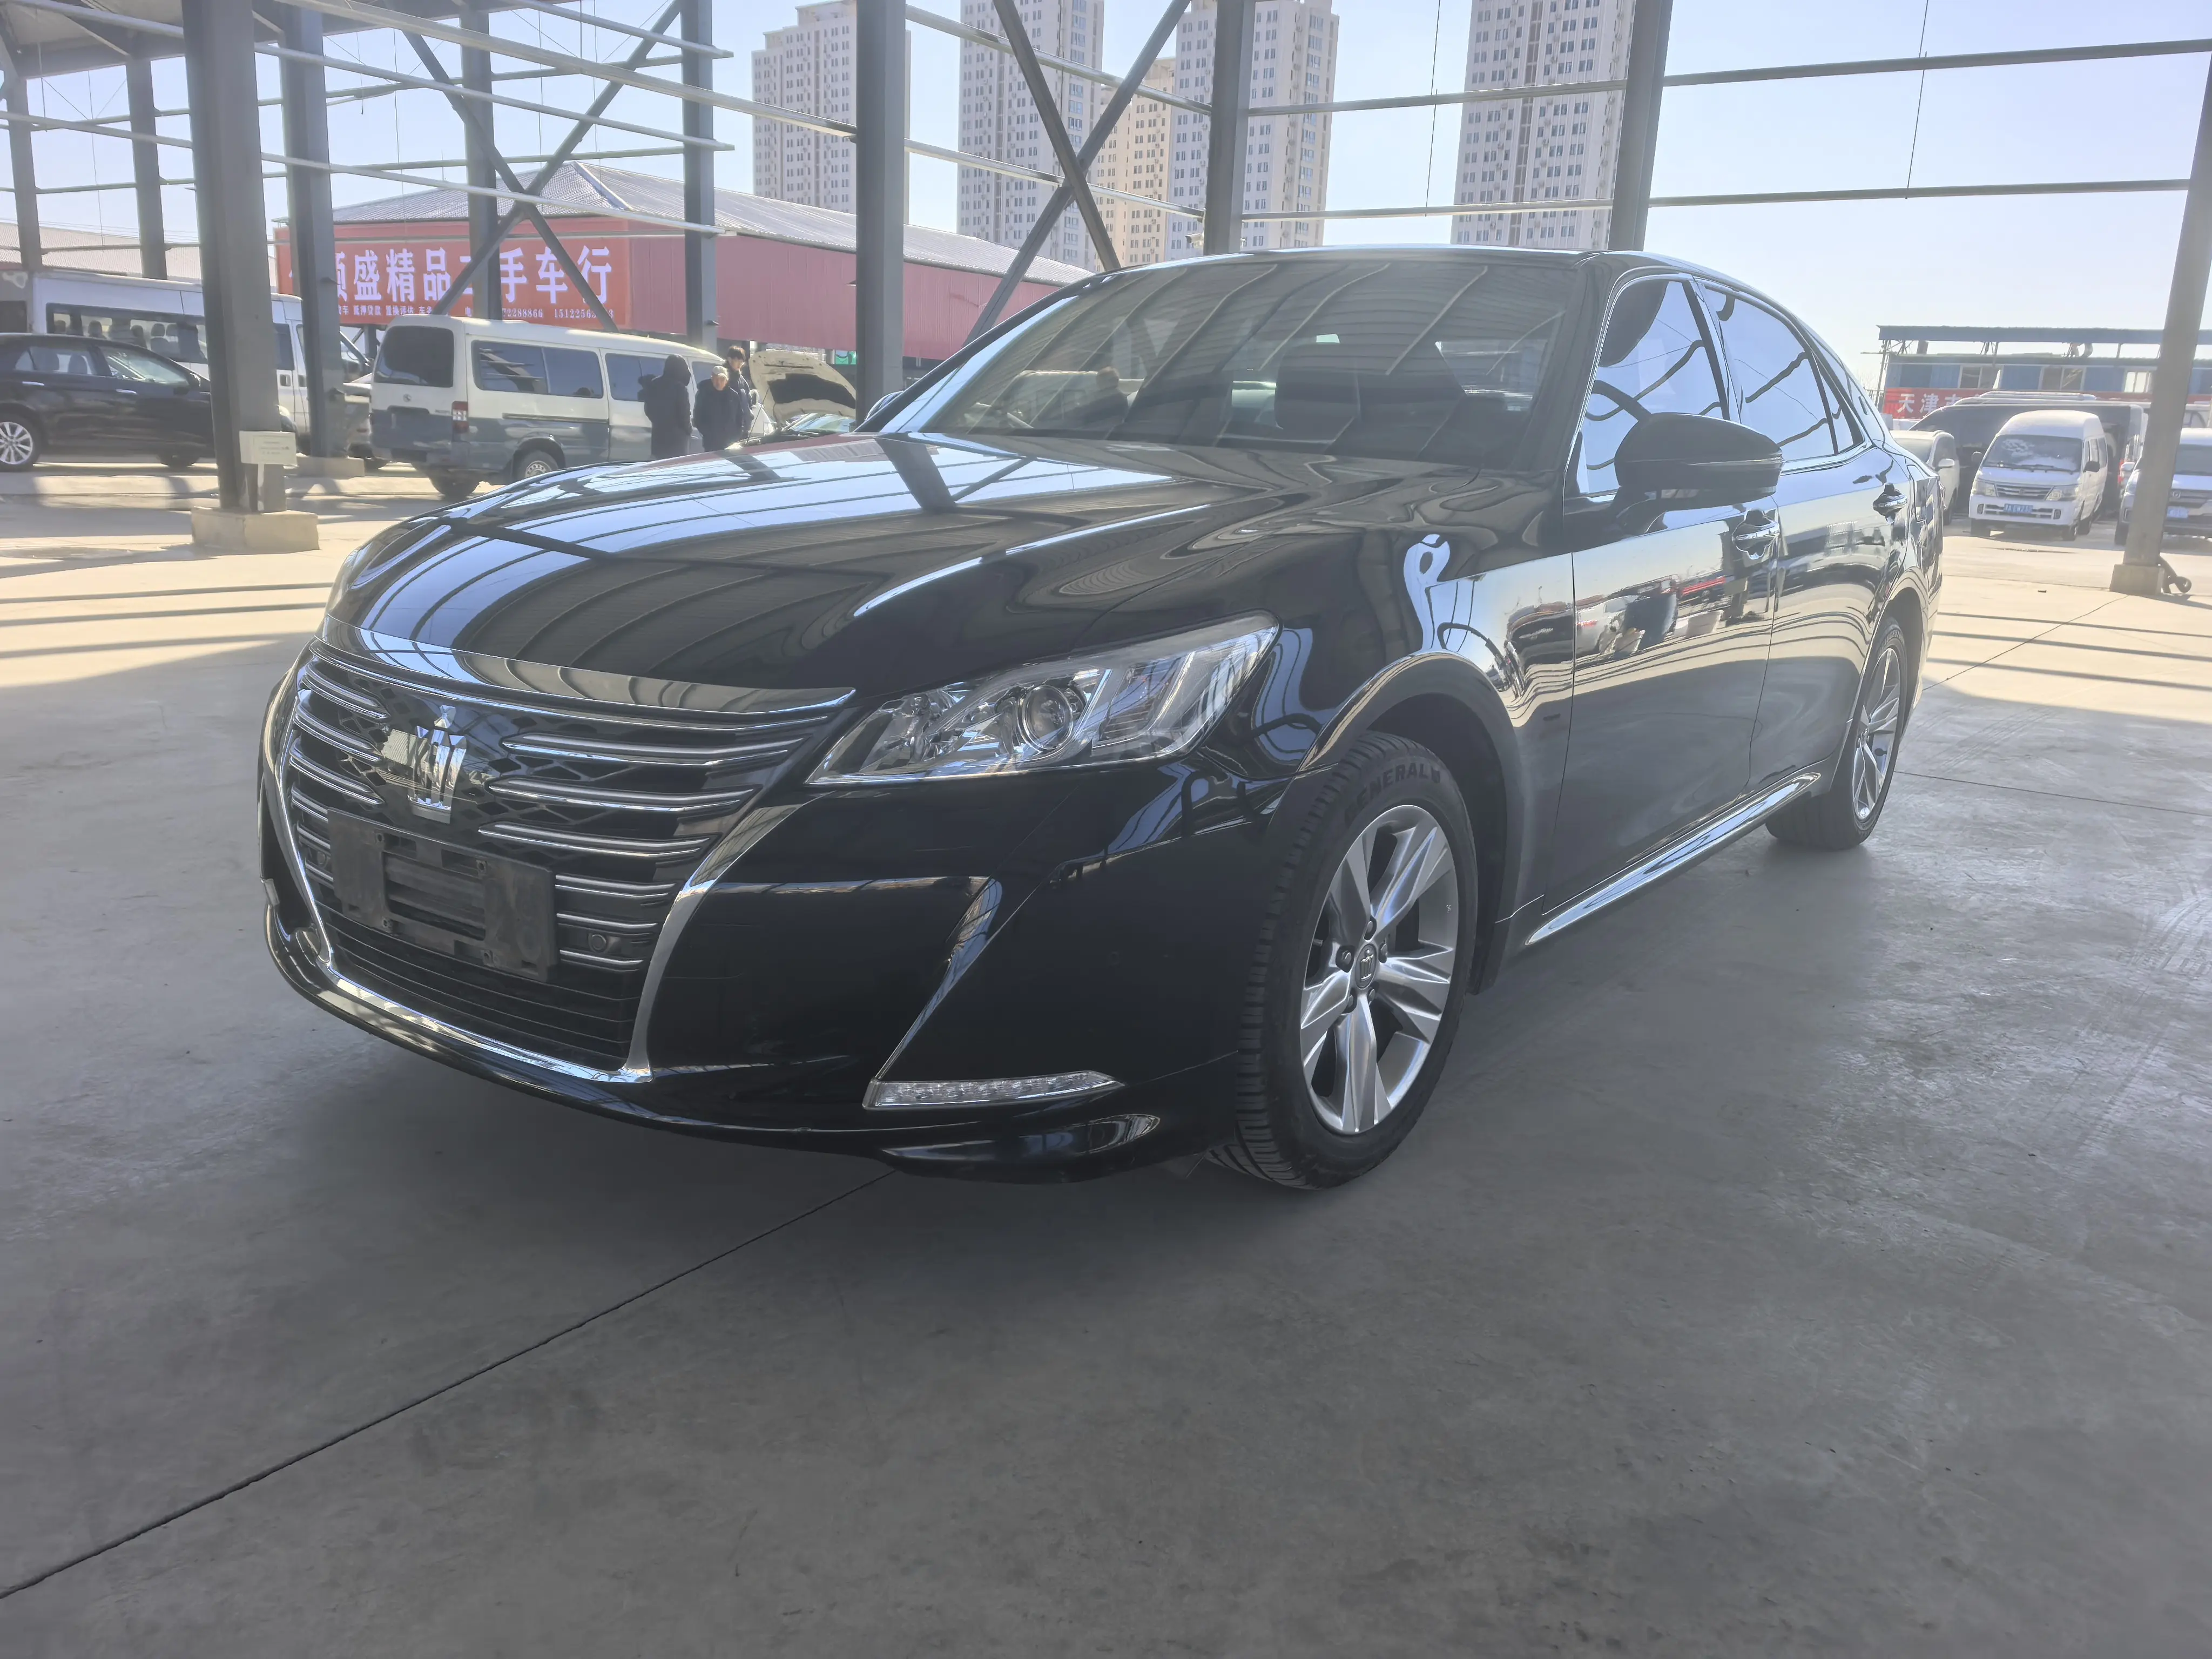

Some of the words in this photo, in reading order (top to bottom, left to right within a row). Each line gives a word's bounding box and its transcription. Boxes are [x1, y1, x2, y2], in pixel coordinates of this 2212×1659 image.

[289, 245, 612, 304] 盛精品手车行
